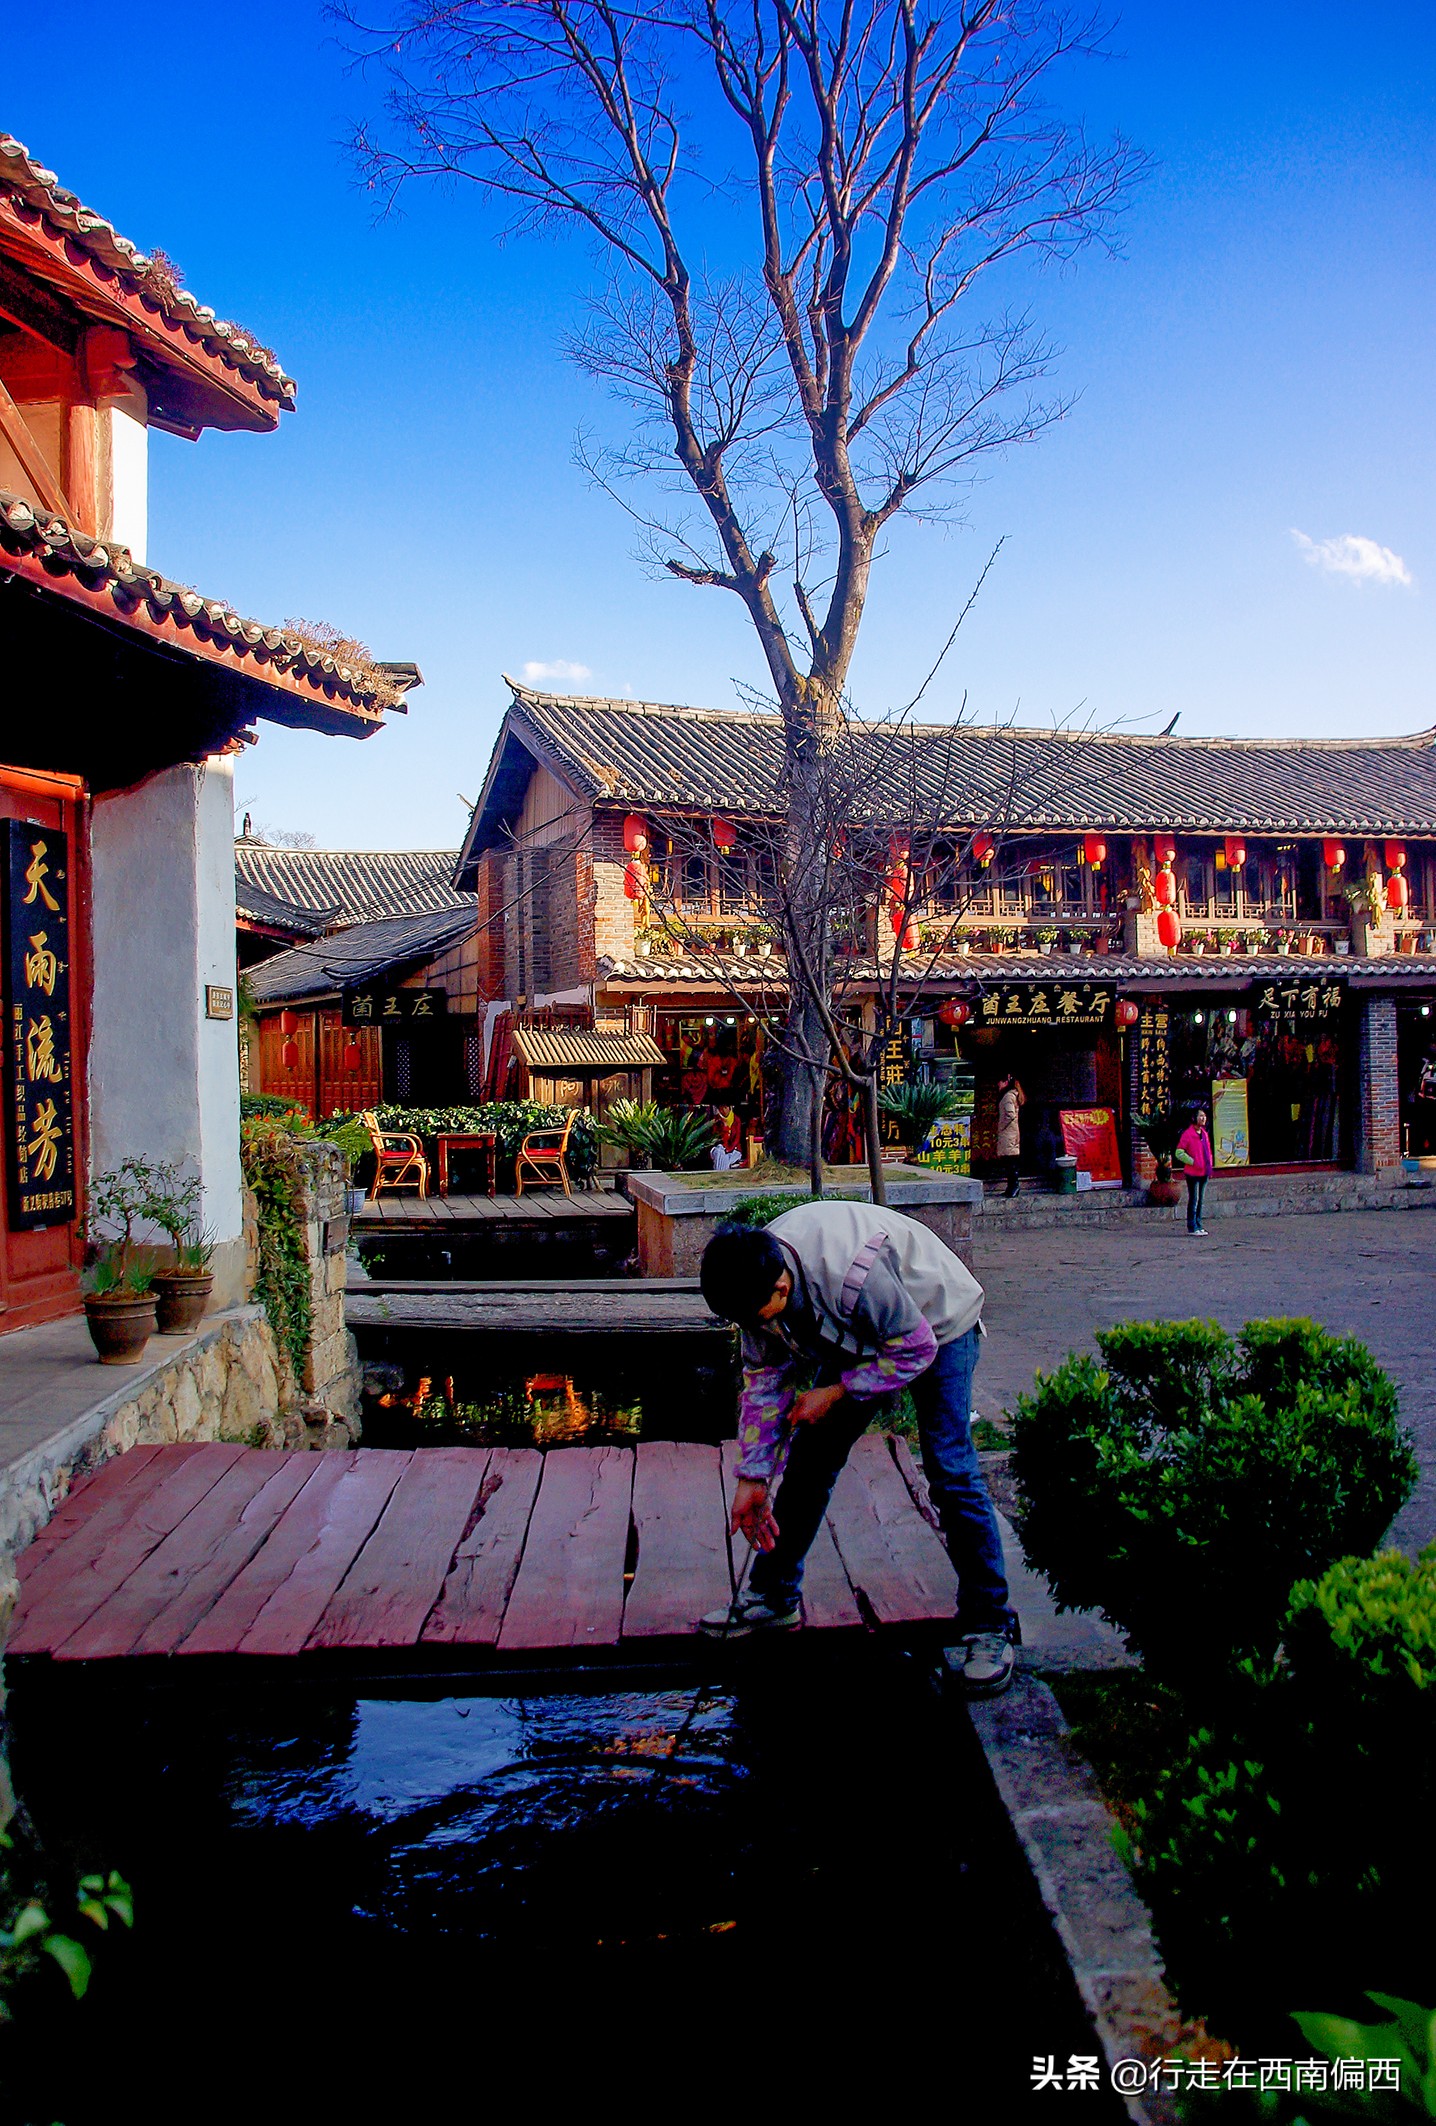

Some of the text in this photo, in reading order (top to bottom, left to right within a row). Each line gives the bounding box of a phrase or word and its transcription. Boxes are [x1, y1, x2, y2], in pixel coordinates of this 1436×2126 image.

[351, 992, 434, 1019] 菌王庄
[982, 990, 1111, 1016] 菌王庄餐厅
[1258, 985, 1343, 1010] 足下有福
[22, 839, 63, 1182] 天雨流芳
[986, 1015, 1105, 1025] JUNWANGZHUANG RESTAURANT
[1140, 1011, 1169, 1029] 主营
[1270, 1009, 1328, 1019] ZU XIA YOU FU
